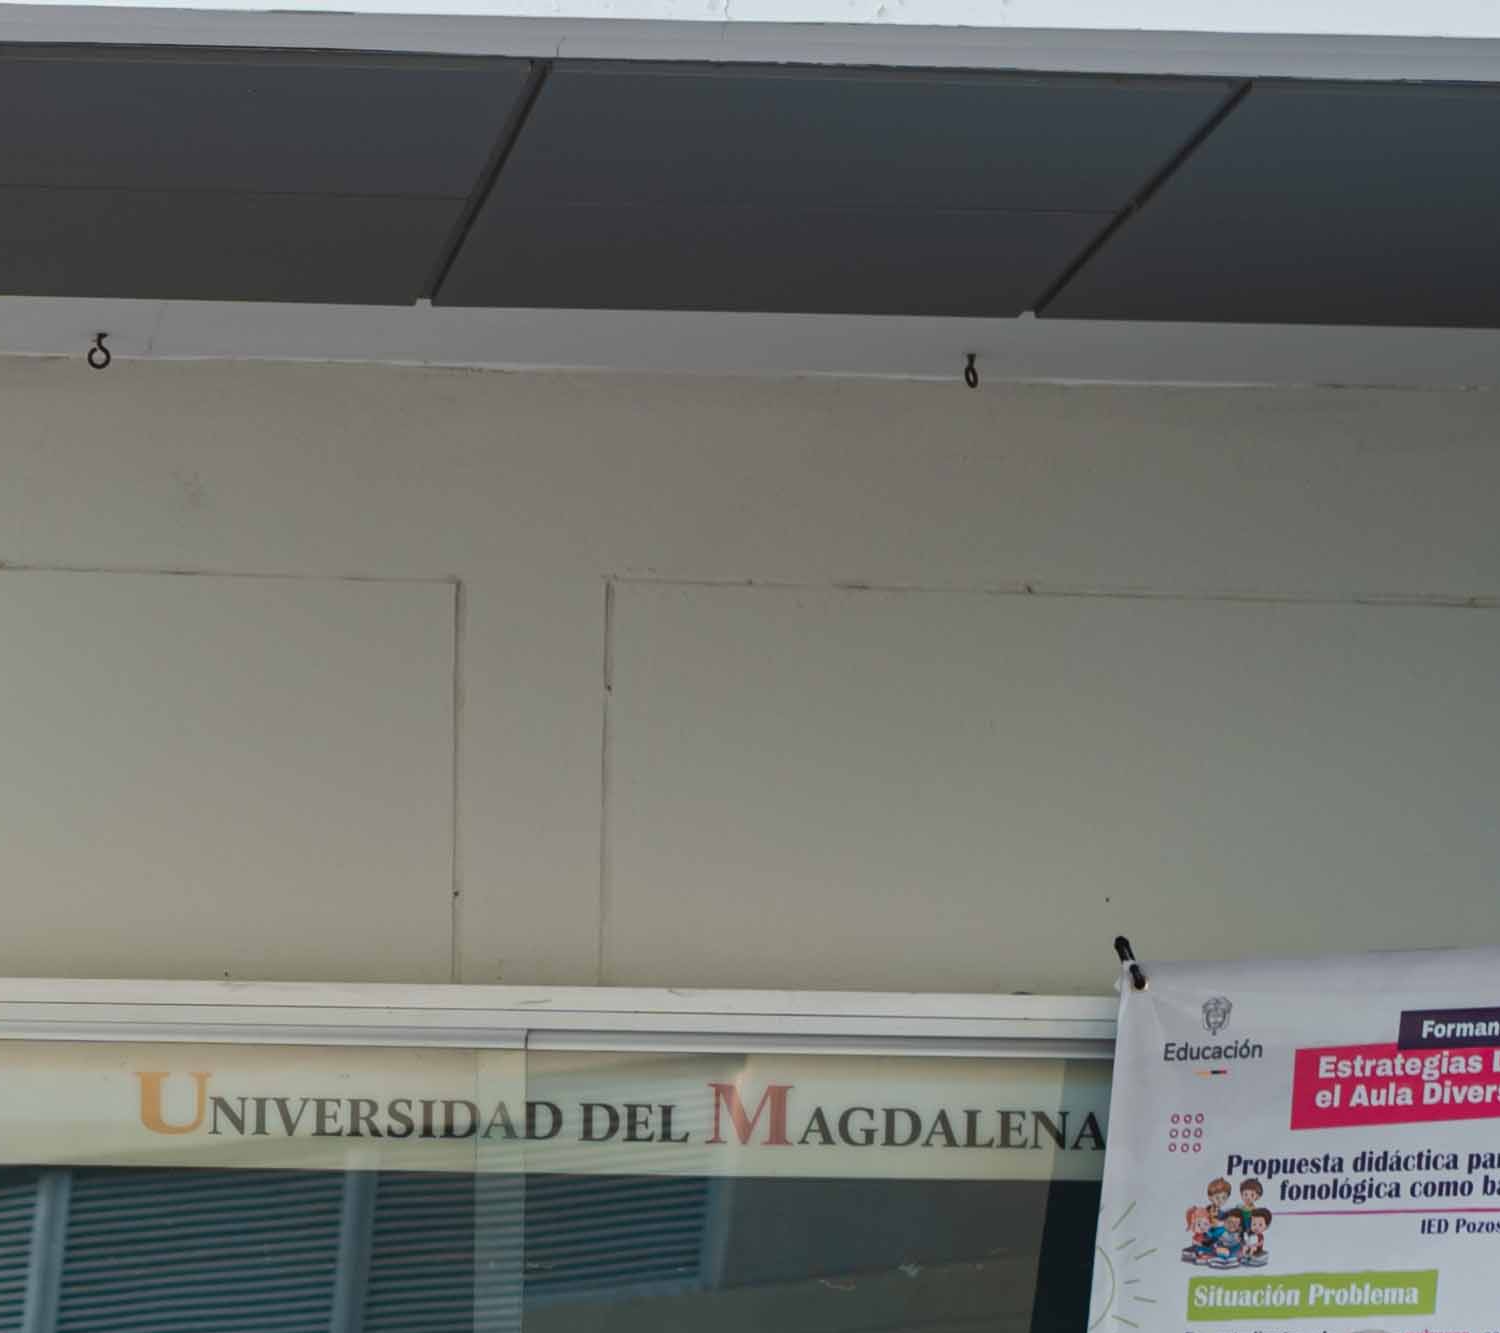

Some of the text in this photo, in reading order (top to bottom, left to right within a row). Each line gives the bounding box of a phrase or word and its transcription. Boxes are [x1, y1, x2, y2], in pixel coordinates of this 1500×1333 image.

[1163, 1038, 1263, 1062] Educación
[1318, 1050, 1483, 1079] Estrategias
[1315, 1083, 1341, 1108] el
[1349, 1081, 1413, 1107] Aula
[135, 1072, 1107, 1152] UNIVERSIDAD DEL MAGDALENA
[1226, 1153, 1344, 1179] Propuesta
[1352, 1148, 1459, 1173] didáctica
[1279, 1176, 1400, 1204] fonológica
[1409, 1180, 1473, 1198] como
[1420, 1218, 1449, 1234] IED
[1193, 1282, 1419, 1307] Situación Problema
